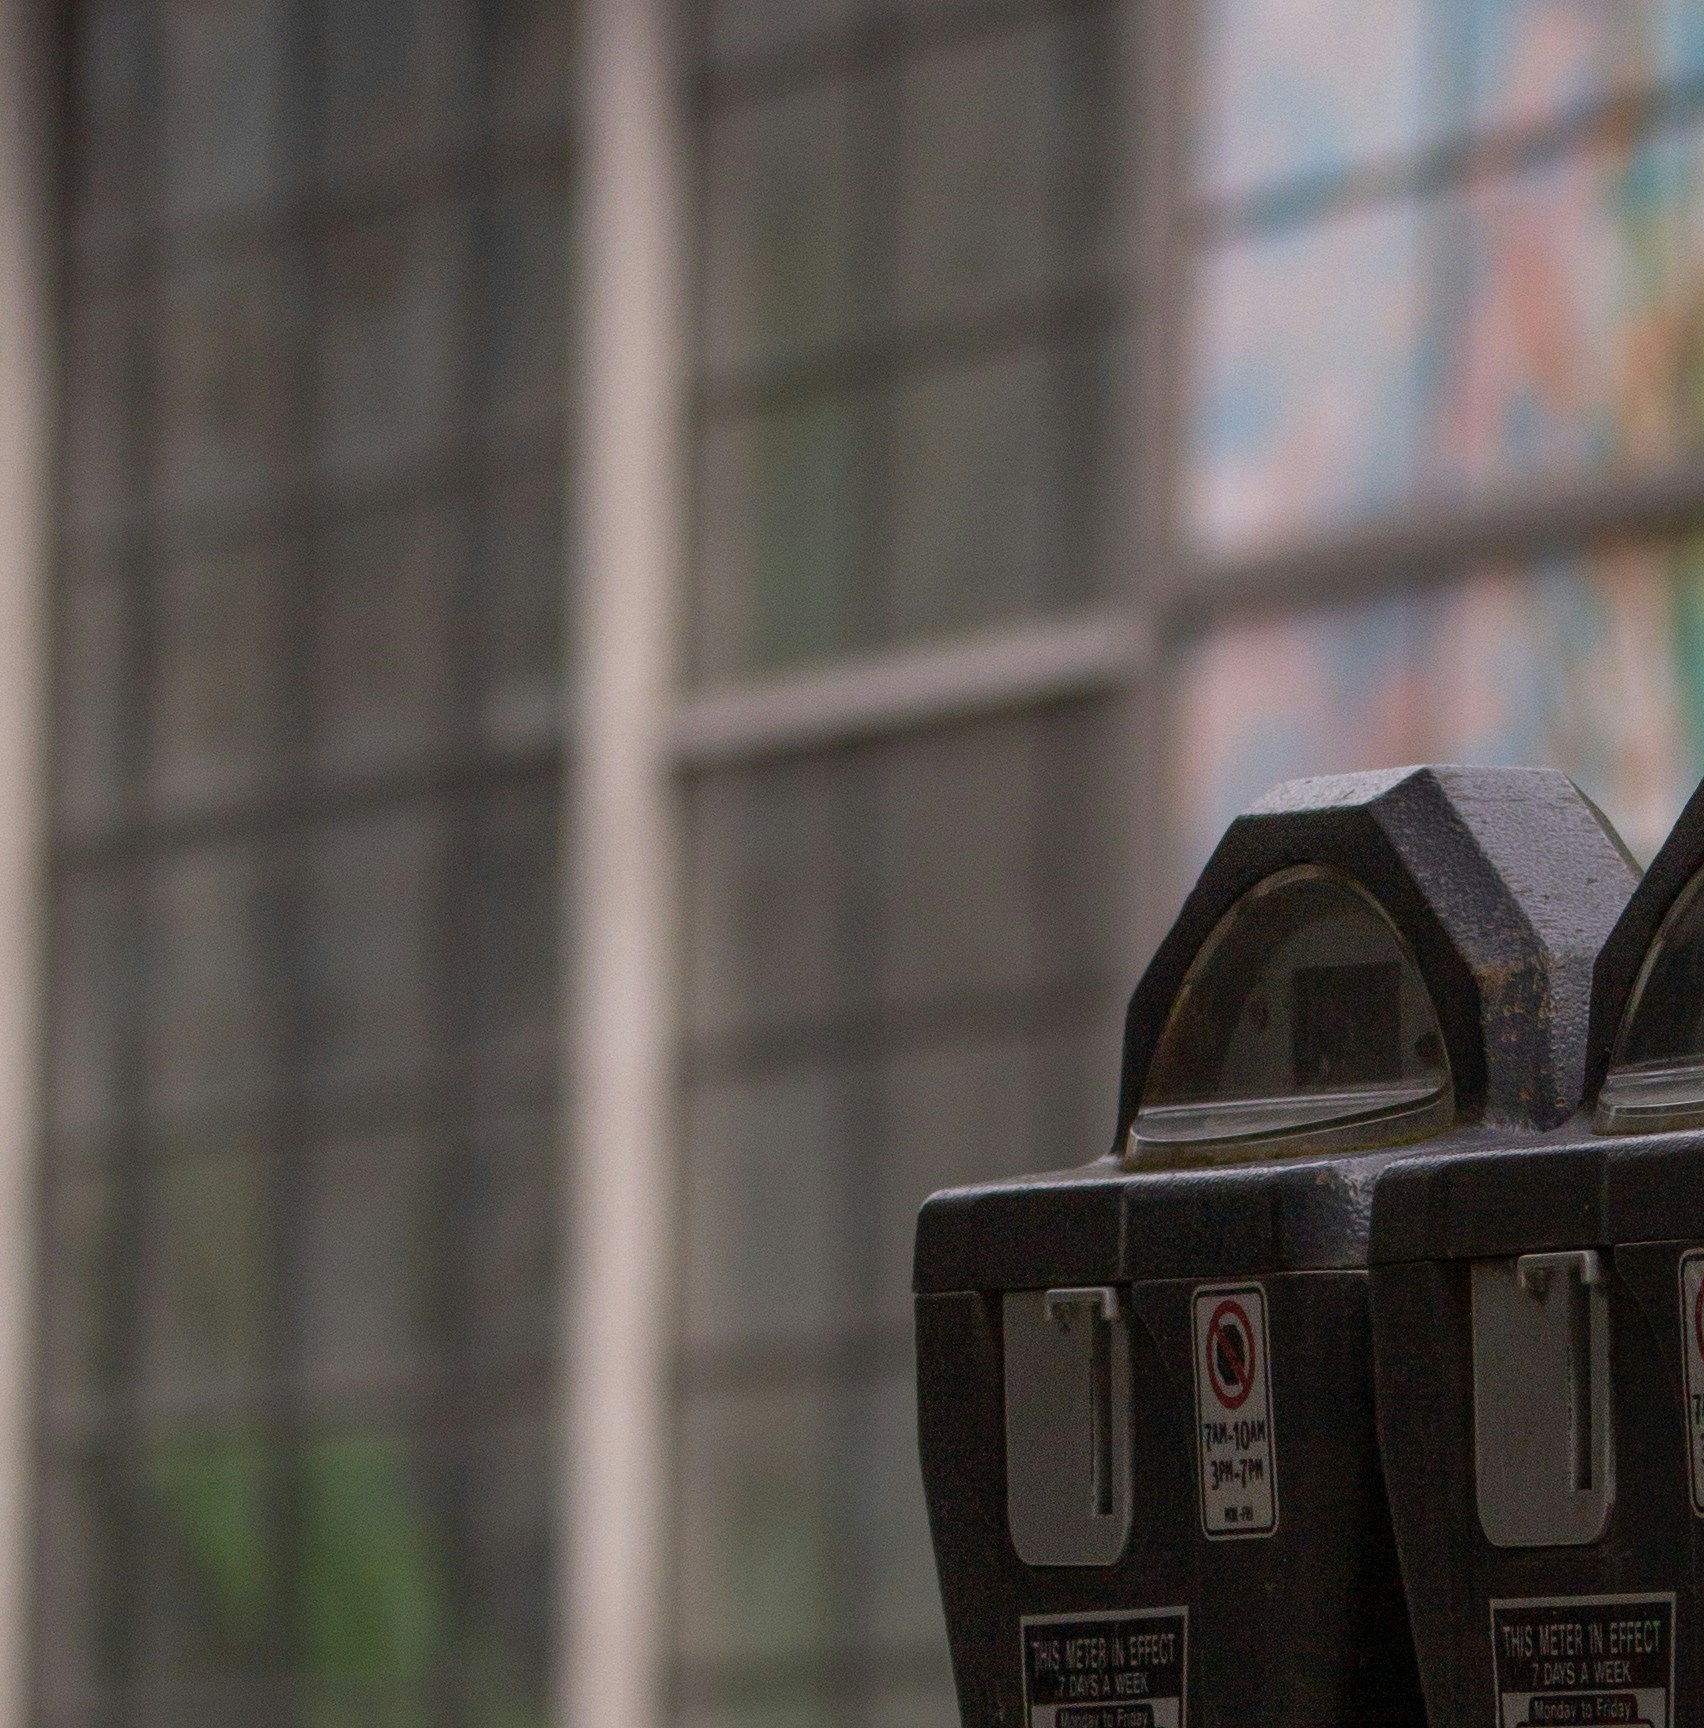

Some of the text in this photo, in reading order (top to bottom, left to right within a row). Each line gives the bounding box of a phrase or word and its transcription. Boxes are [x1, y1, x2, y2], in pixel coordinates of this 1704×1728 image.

[1203, 1420, 1266, 1452] 7AM-10AM
[1210, 1458, 1264, 1490] 3PM-7PM
[1030, 1633, 1176, 1671] THIS METER IN EFFECT
[1502, 1619, 1662, 1657] THIS METER IN EFFECT
[1070, 1673, 1099, 1697] DAYS
[1101, 1673, 1112, 1695] A
[1115, 1671, 1150, 1694] WEEK
[1531, 1660, 1632, 1686] 7 DAYS A WEEK
[1533, 1697, 1632, 1719] Monday to Friday
